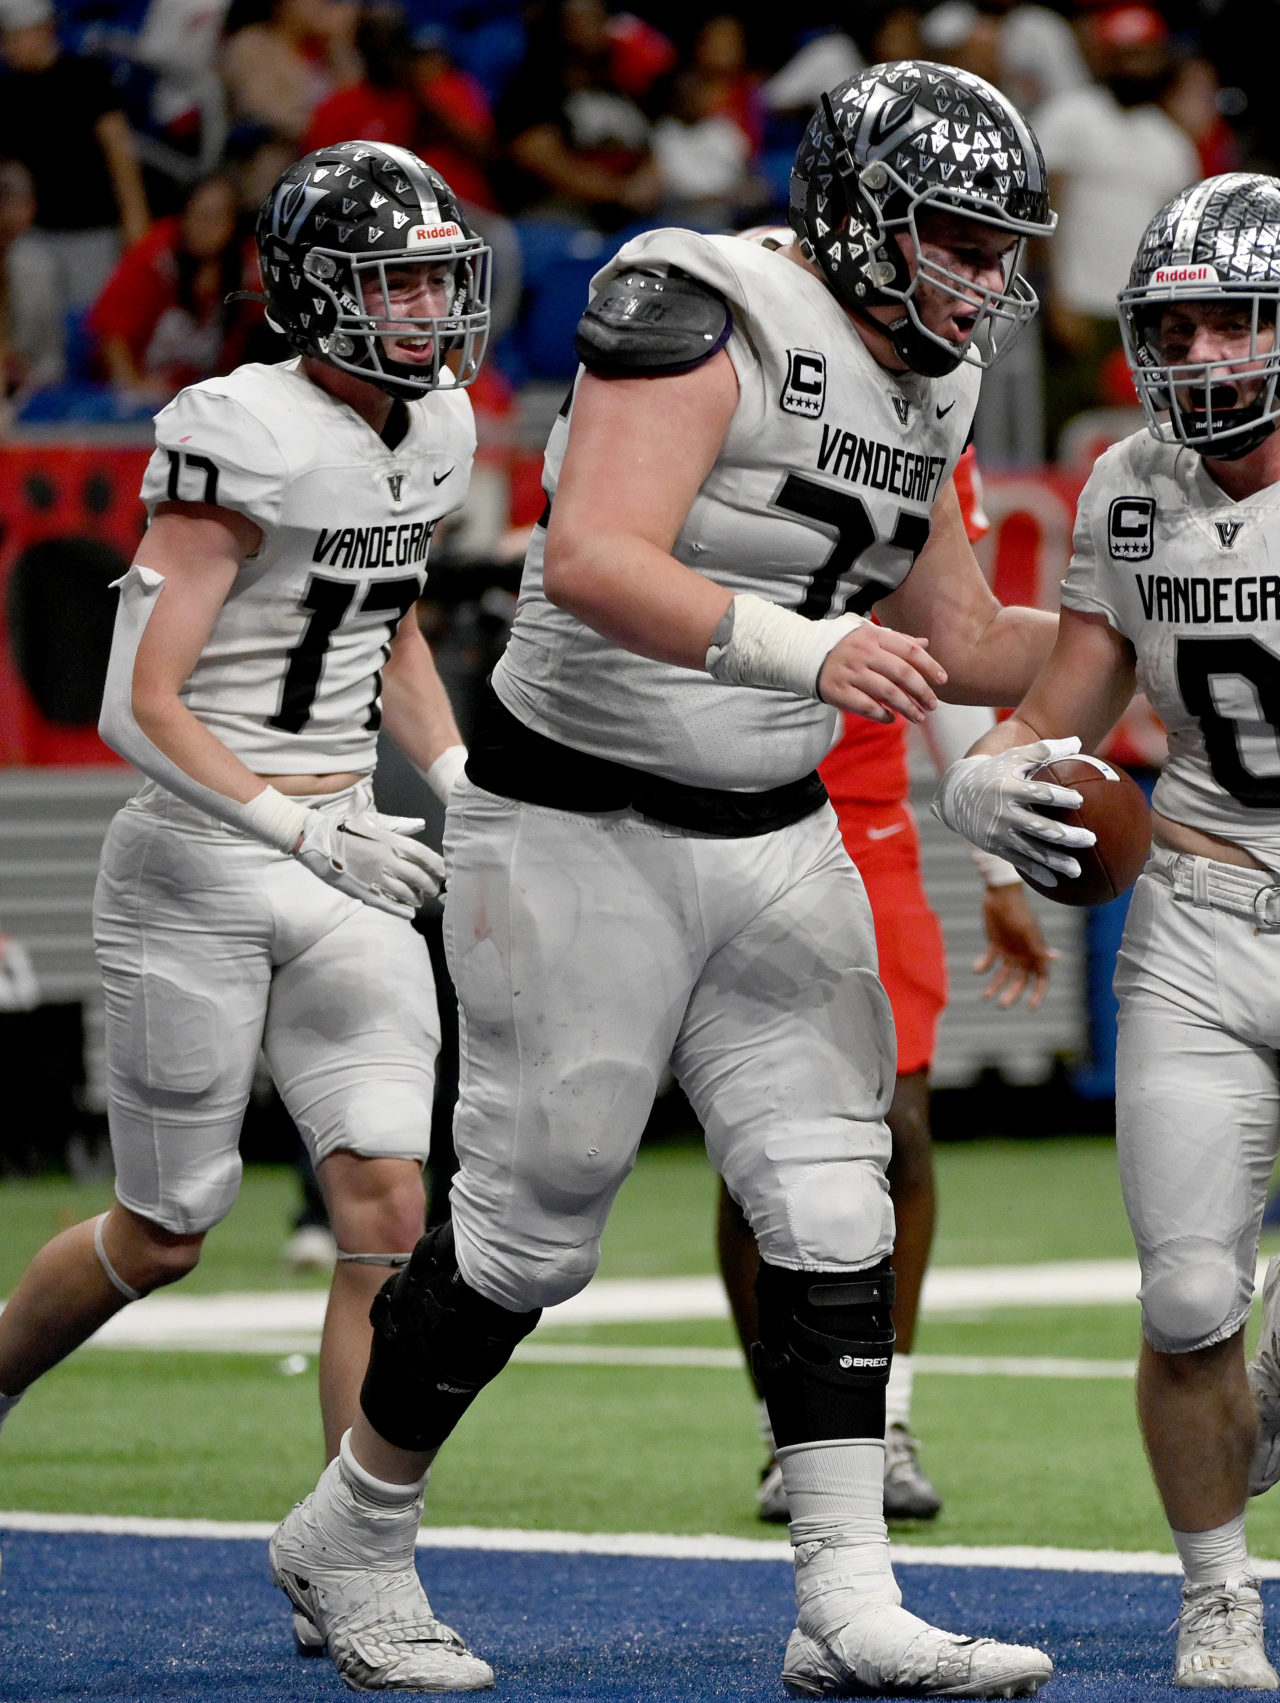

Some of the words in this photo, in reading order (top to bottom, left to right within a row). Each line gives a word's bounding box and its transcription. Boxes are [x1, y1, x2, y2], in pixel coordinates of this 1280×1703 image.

[417, 225, 459, 240] Riddell
[1156, 268, 1207, 282] Riddell
[166, 450, 219, 504] 17
[817, 423, 947, 503] VANDEGRIFT
[265, 572, 423, 735] 17
[853, 1357, 888, 1368] BREG
